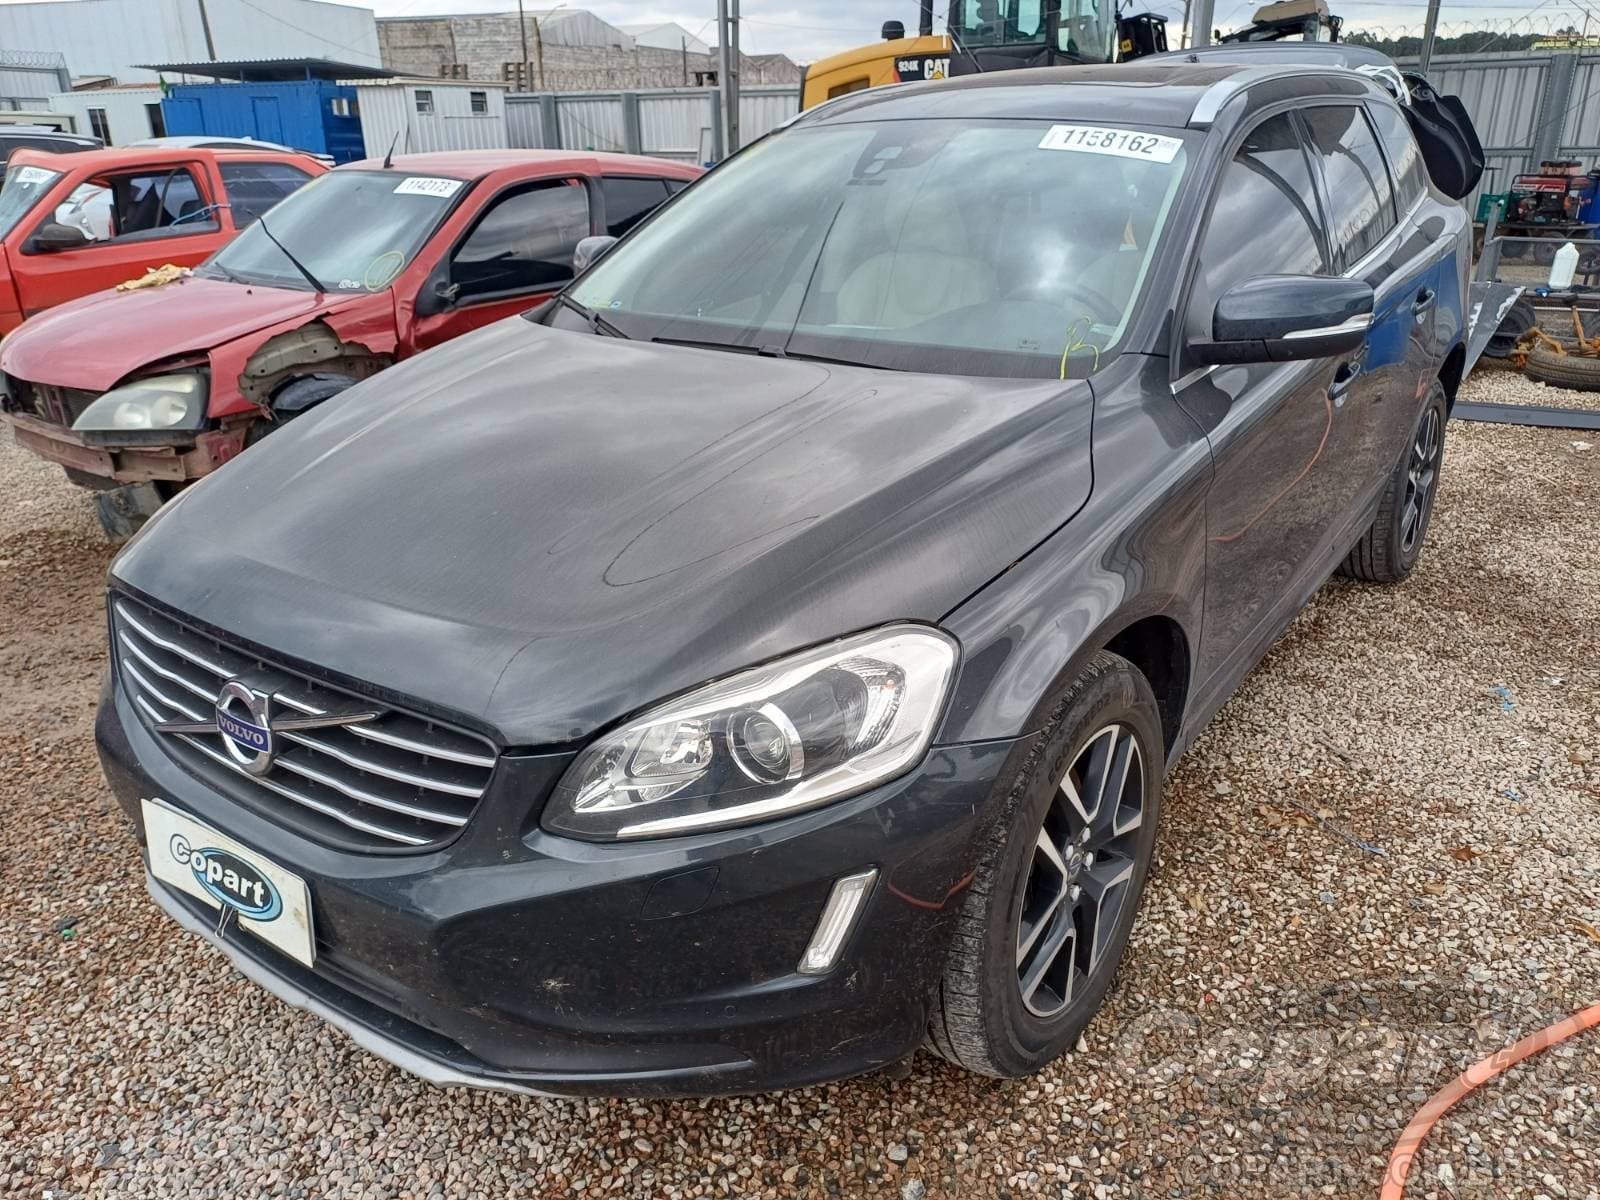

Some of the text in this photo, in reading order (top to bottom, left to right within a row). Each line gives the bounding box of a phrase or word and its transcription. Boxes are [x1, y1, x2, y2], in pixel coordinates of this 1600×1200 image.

[924, 58, 950, 79] CAT
[1064, 129, 1159, 153] 1158162
[217, 714, 265, 746] VOLVO
[169, 833, 265, 907] Copart
